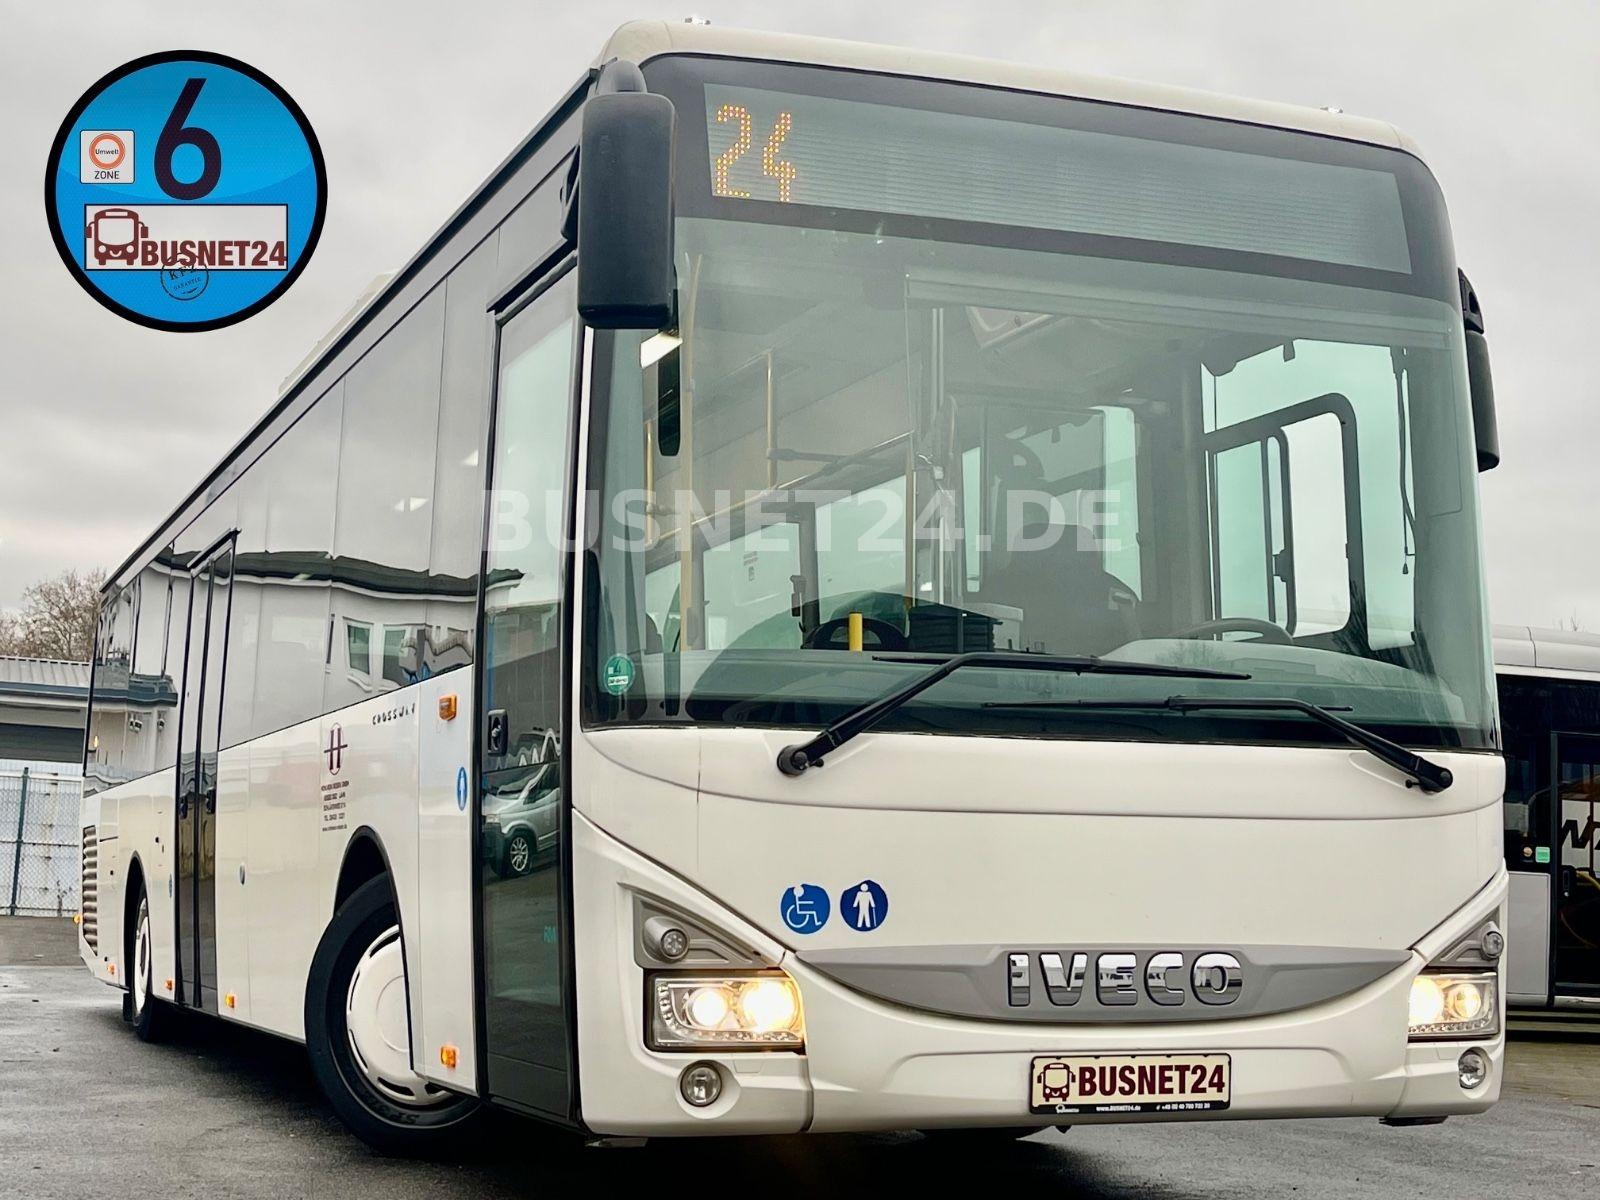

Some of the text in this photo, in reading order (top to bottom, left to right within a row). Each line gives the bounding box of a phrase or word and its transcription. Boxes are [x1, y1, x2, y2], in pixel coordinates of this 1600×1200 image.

[717, 104, 797, 202] 24
[1007, 952, 1243, 1007] IVECO
[1078, 1064, 1226, 1097] BUSNET24
